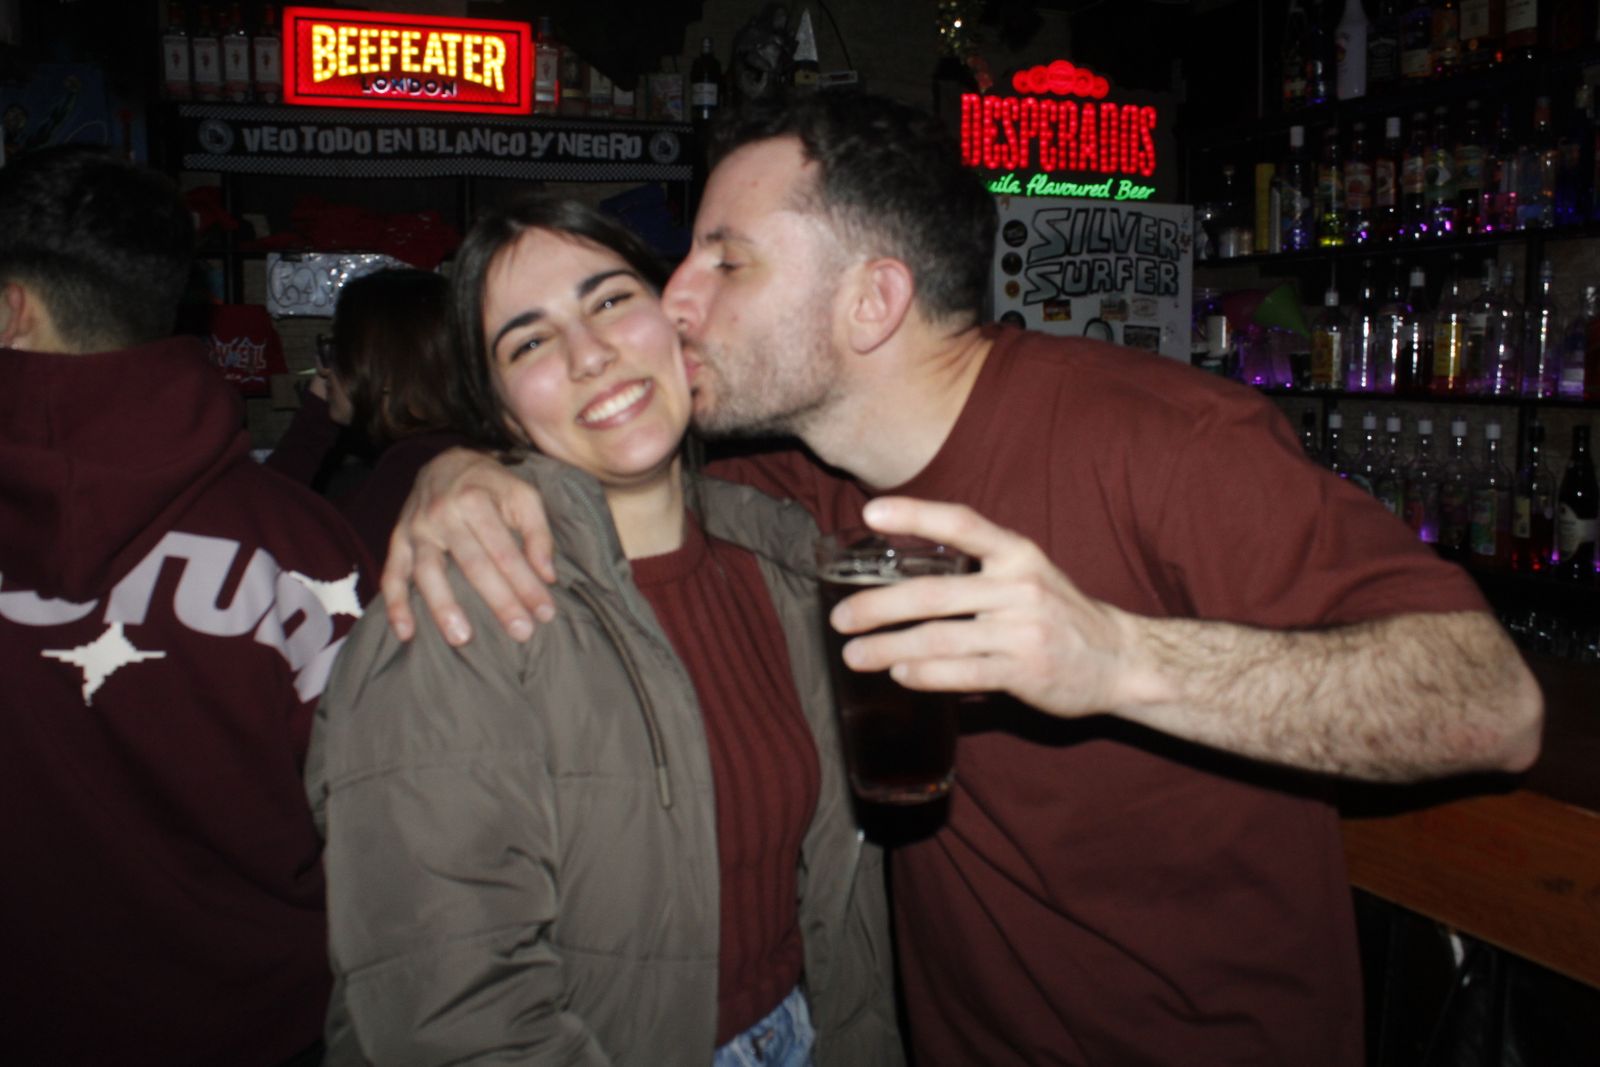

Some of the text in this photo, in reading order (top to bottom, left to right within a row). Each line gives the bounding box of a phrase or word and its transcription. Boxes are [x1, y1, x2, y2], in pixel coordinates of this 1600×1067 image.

[312, 24, 506, 92] BEEFEATER
[361, 77, 458, 97] LONDON
[241, 125, 298, 153] VEO
[377, 127, 413, 154] EN
[418, 126, 527, 157] BLANCO
[557, 131, 643, 160] NEGRO
[961, 93, 1157, 176] DESPERADOS
[1114, 180, 1155, 200] Beer
[1027, 208, 1180, 264] SILVER
[1022, 256, 1180, 306] SURFER
